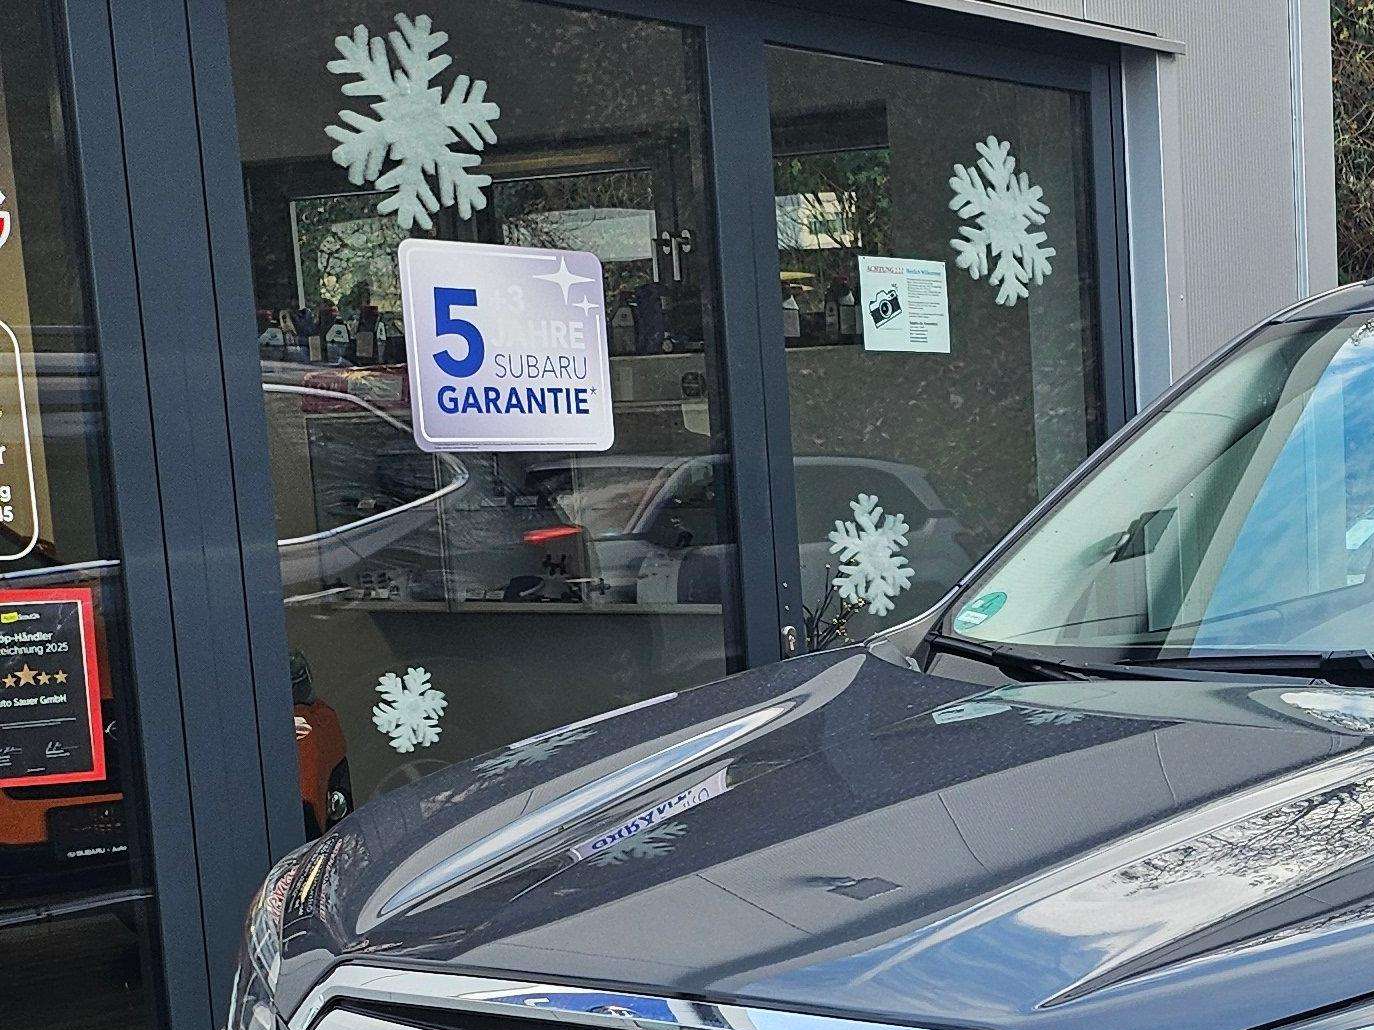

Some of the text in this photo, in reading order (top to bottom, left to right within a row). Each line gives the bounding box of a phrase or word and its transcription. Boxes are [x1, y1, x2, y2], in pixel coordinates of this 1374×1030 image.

[432, 286, 485, 378] 5
[494, 353, 587, 379] SUBARU
[0, 642, 69, 655] eichnung 2025
[13, 697, 38, 707] Sauer
[39, 694, 67, 705] GmbH
